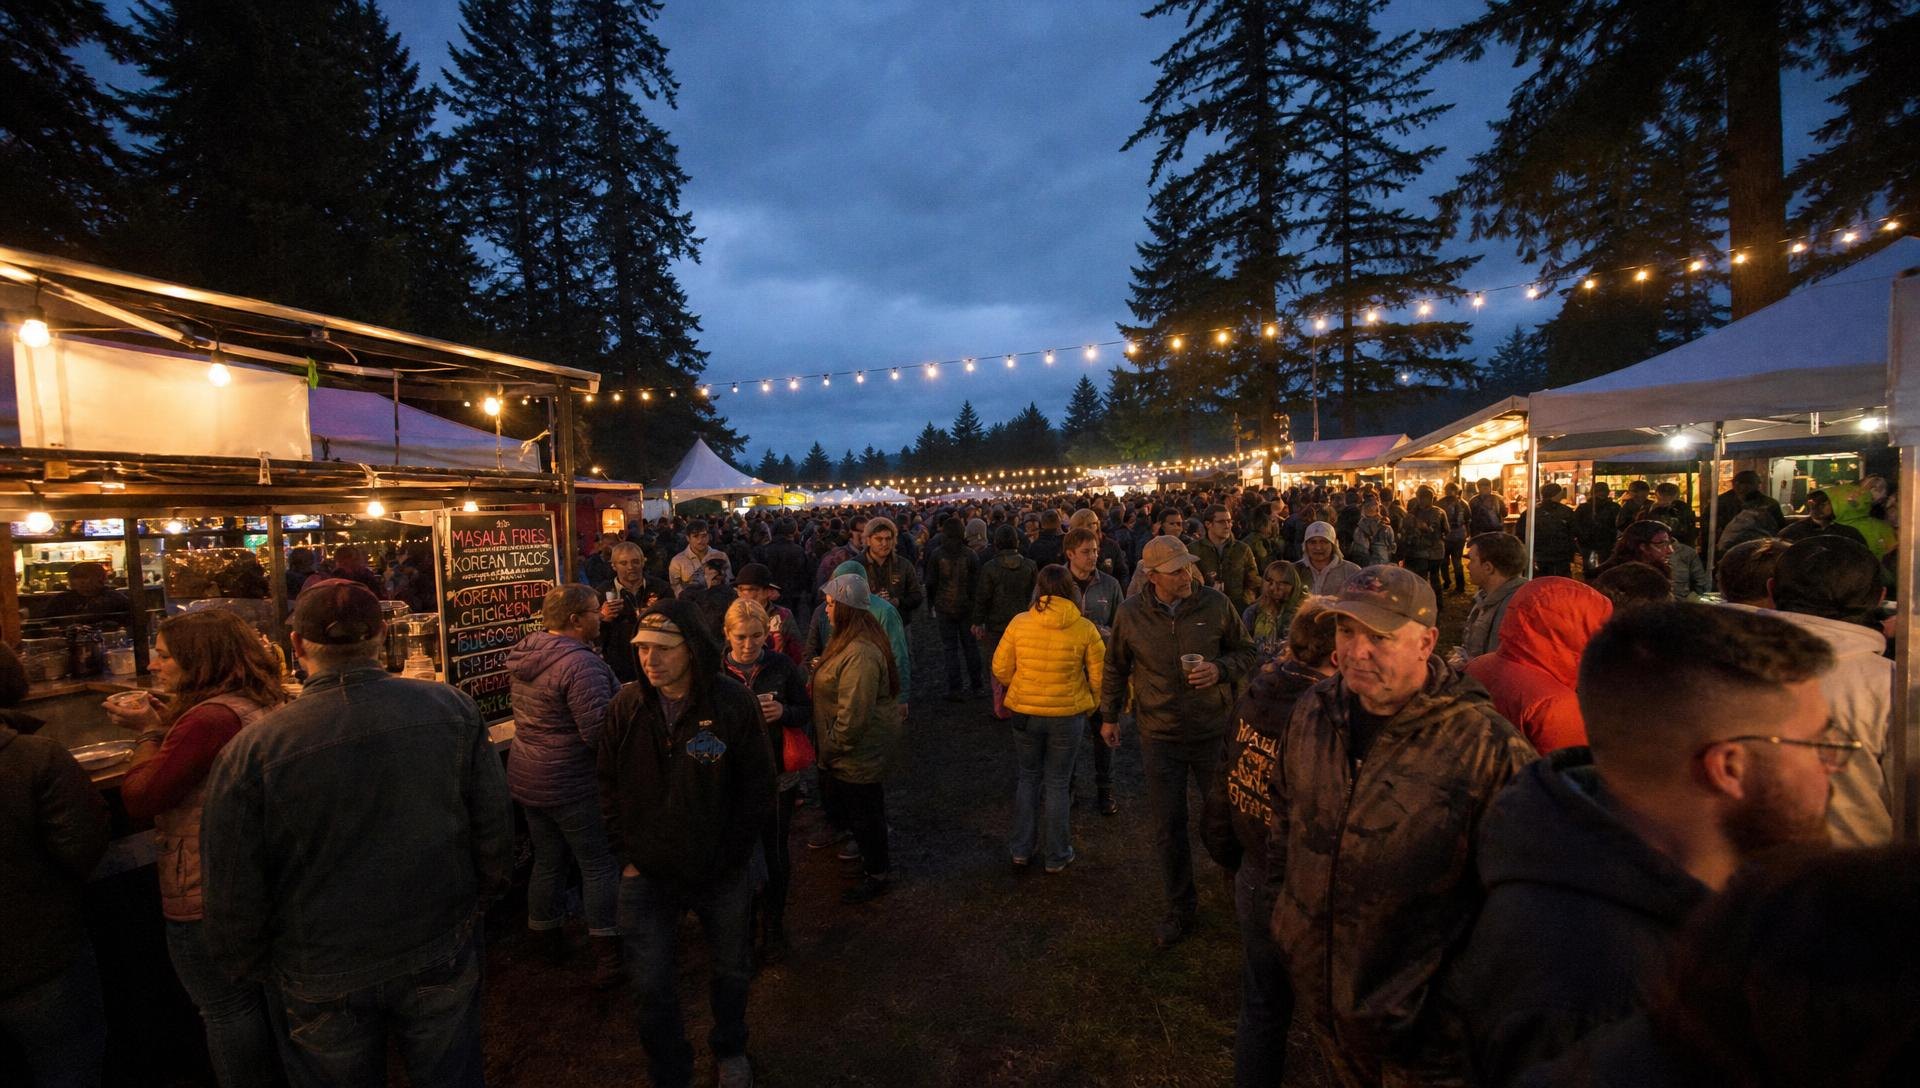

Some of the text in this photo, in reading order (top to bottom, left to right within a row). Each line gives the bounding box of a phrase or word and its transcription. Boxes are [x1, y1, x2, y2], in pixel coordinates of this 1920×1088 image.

[452, 530, 507, 548] MASALA
[511, 528, 545, 545] FRIES
[452, 551, 550, 573] KOREAN TACOS
[454, 582, 550, 608] KOREAN FRIED
